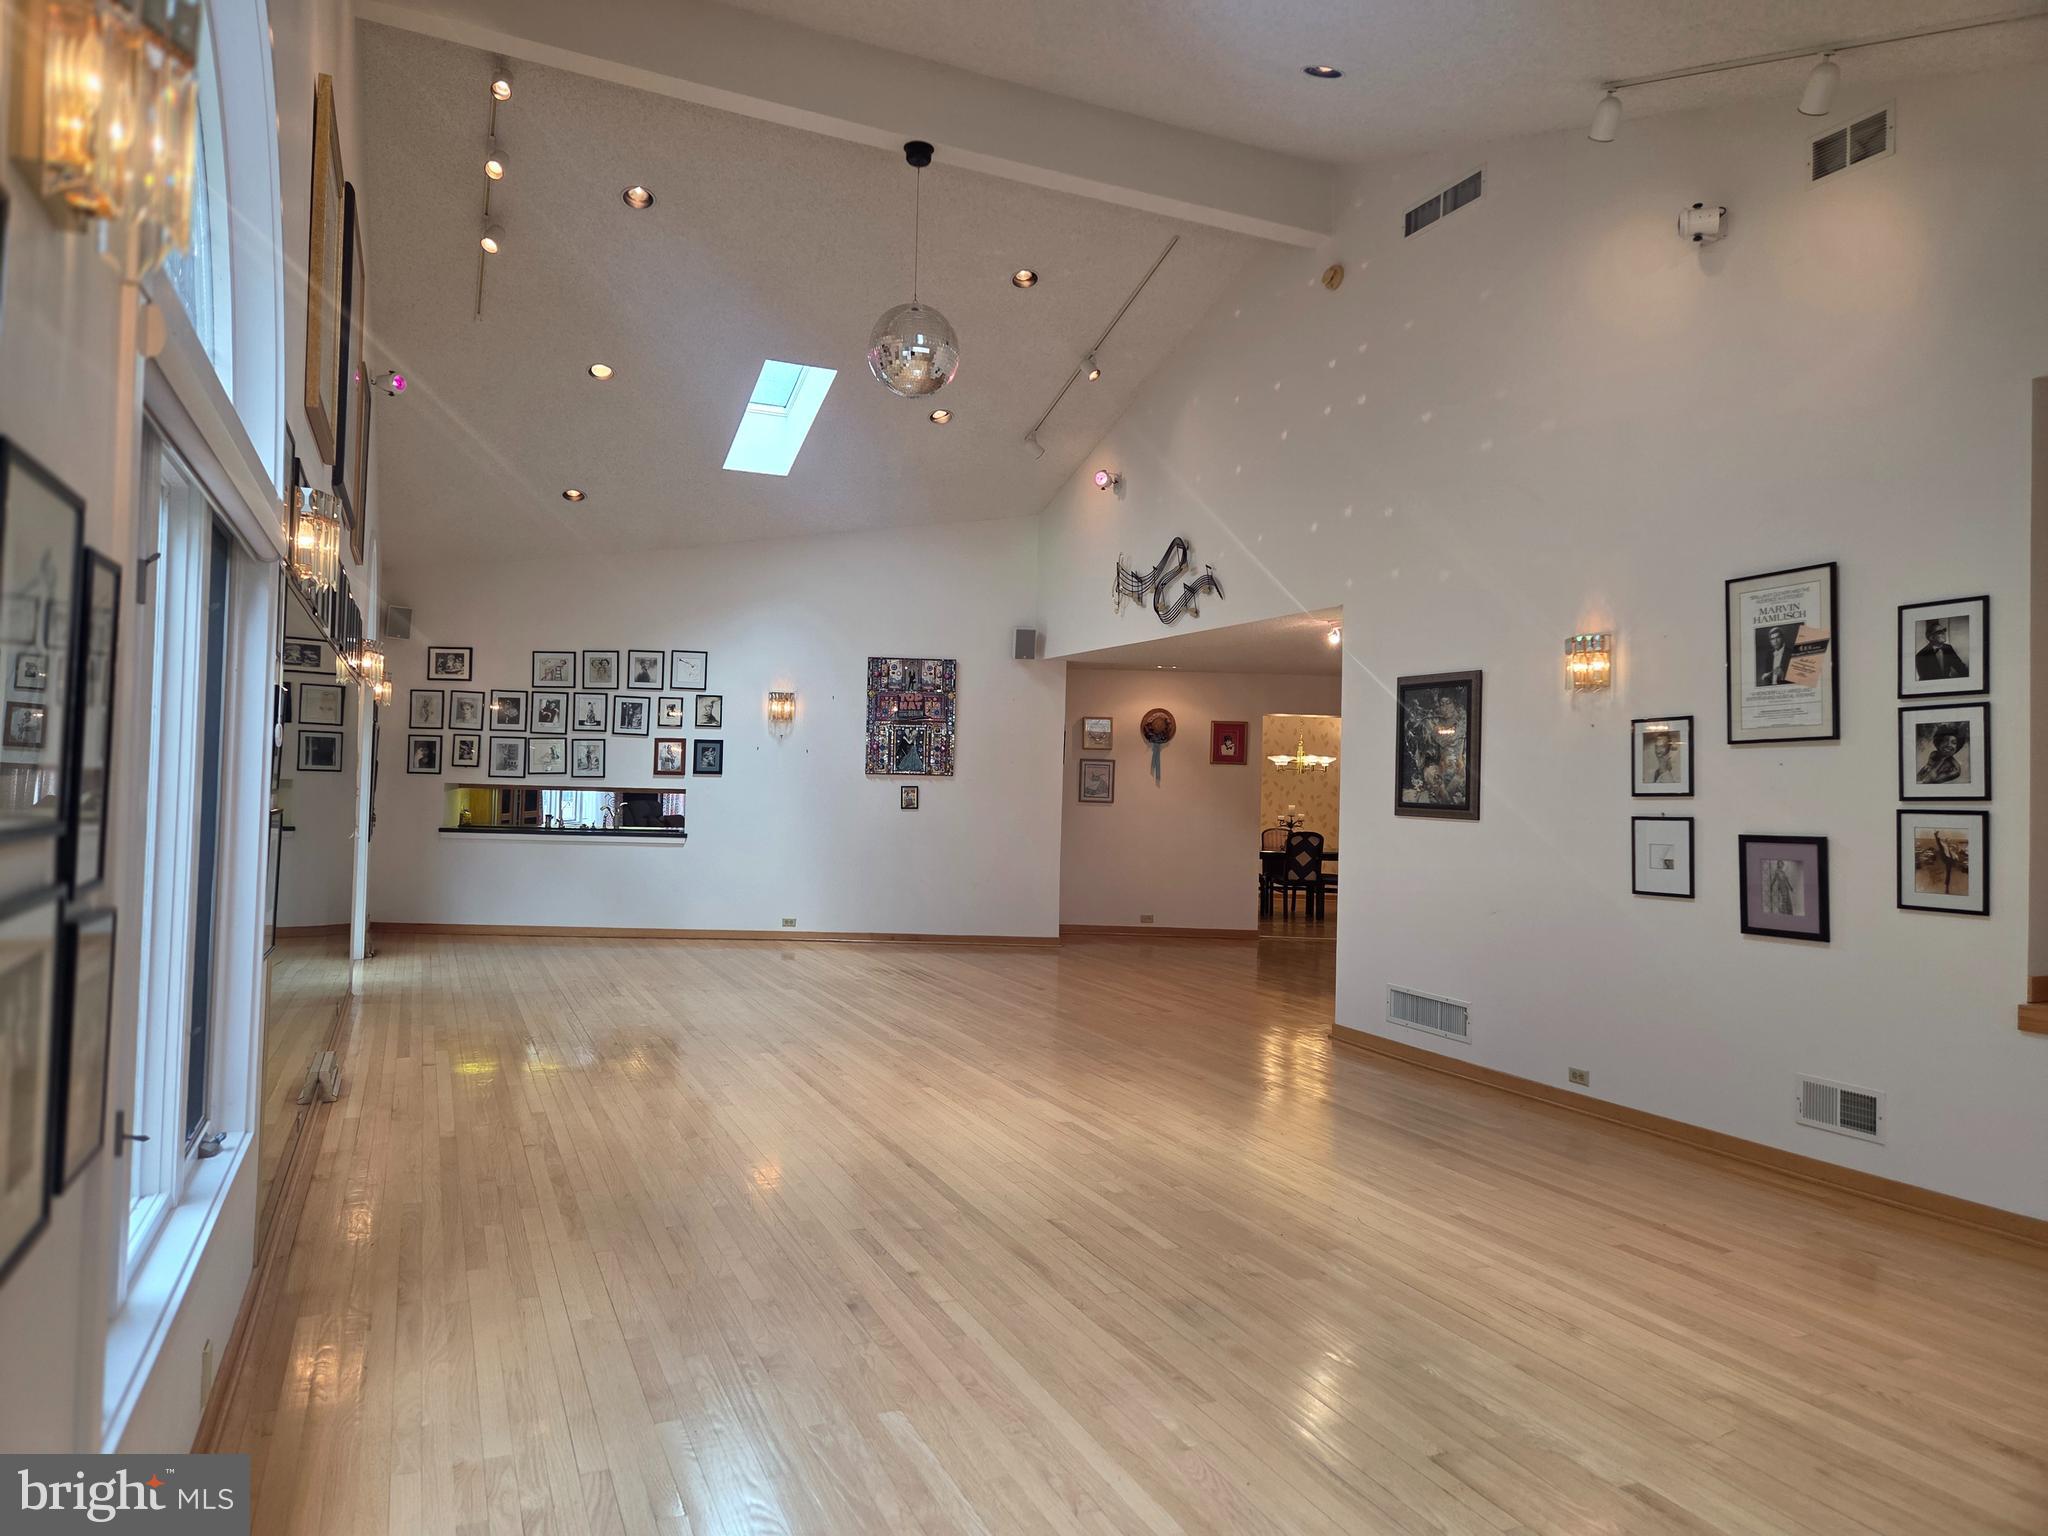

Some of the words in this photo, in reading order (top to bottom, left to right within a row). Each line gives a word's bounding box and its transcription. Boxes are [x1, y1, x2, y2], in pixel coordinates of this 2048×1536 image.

[1759, 603, 1800, 616] MARVIN
[1753, 610, 1807, 624] HAMLISCH
[899, 701, 923, 710] HAT
